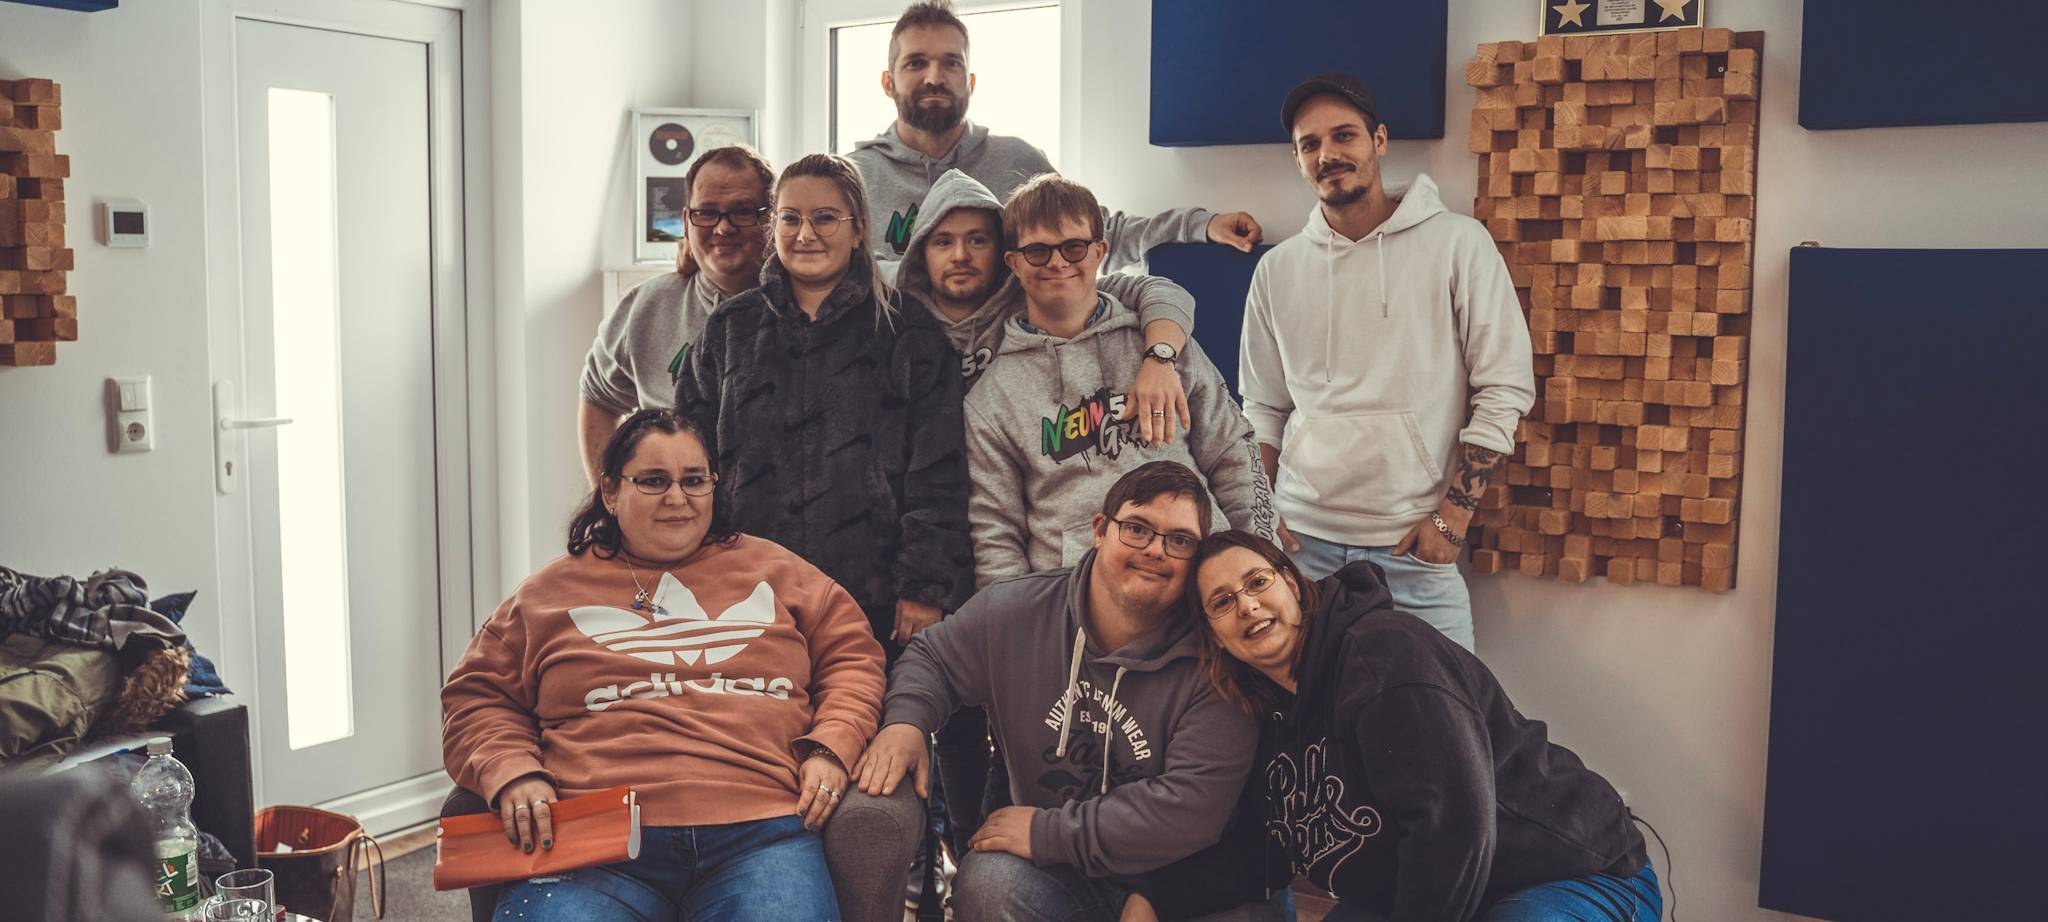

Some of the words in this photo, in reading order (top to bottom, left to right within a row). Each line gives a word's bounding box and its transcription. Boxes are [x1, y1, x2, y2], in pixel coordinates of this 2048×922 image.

[961, 347, 992, 377] 52
[1109, 394, 1128, 421] 5
[584, 672, 793, 712] adidas
[1120, 716, 1152, 761] WEAR
